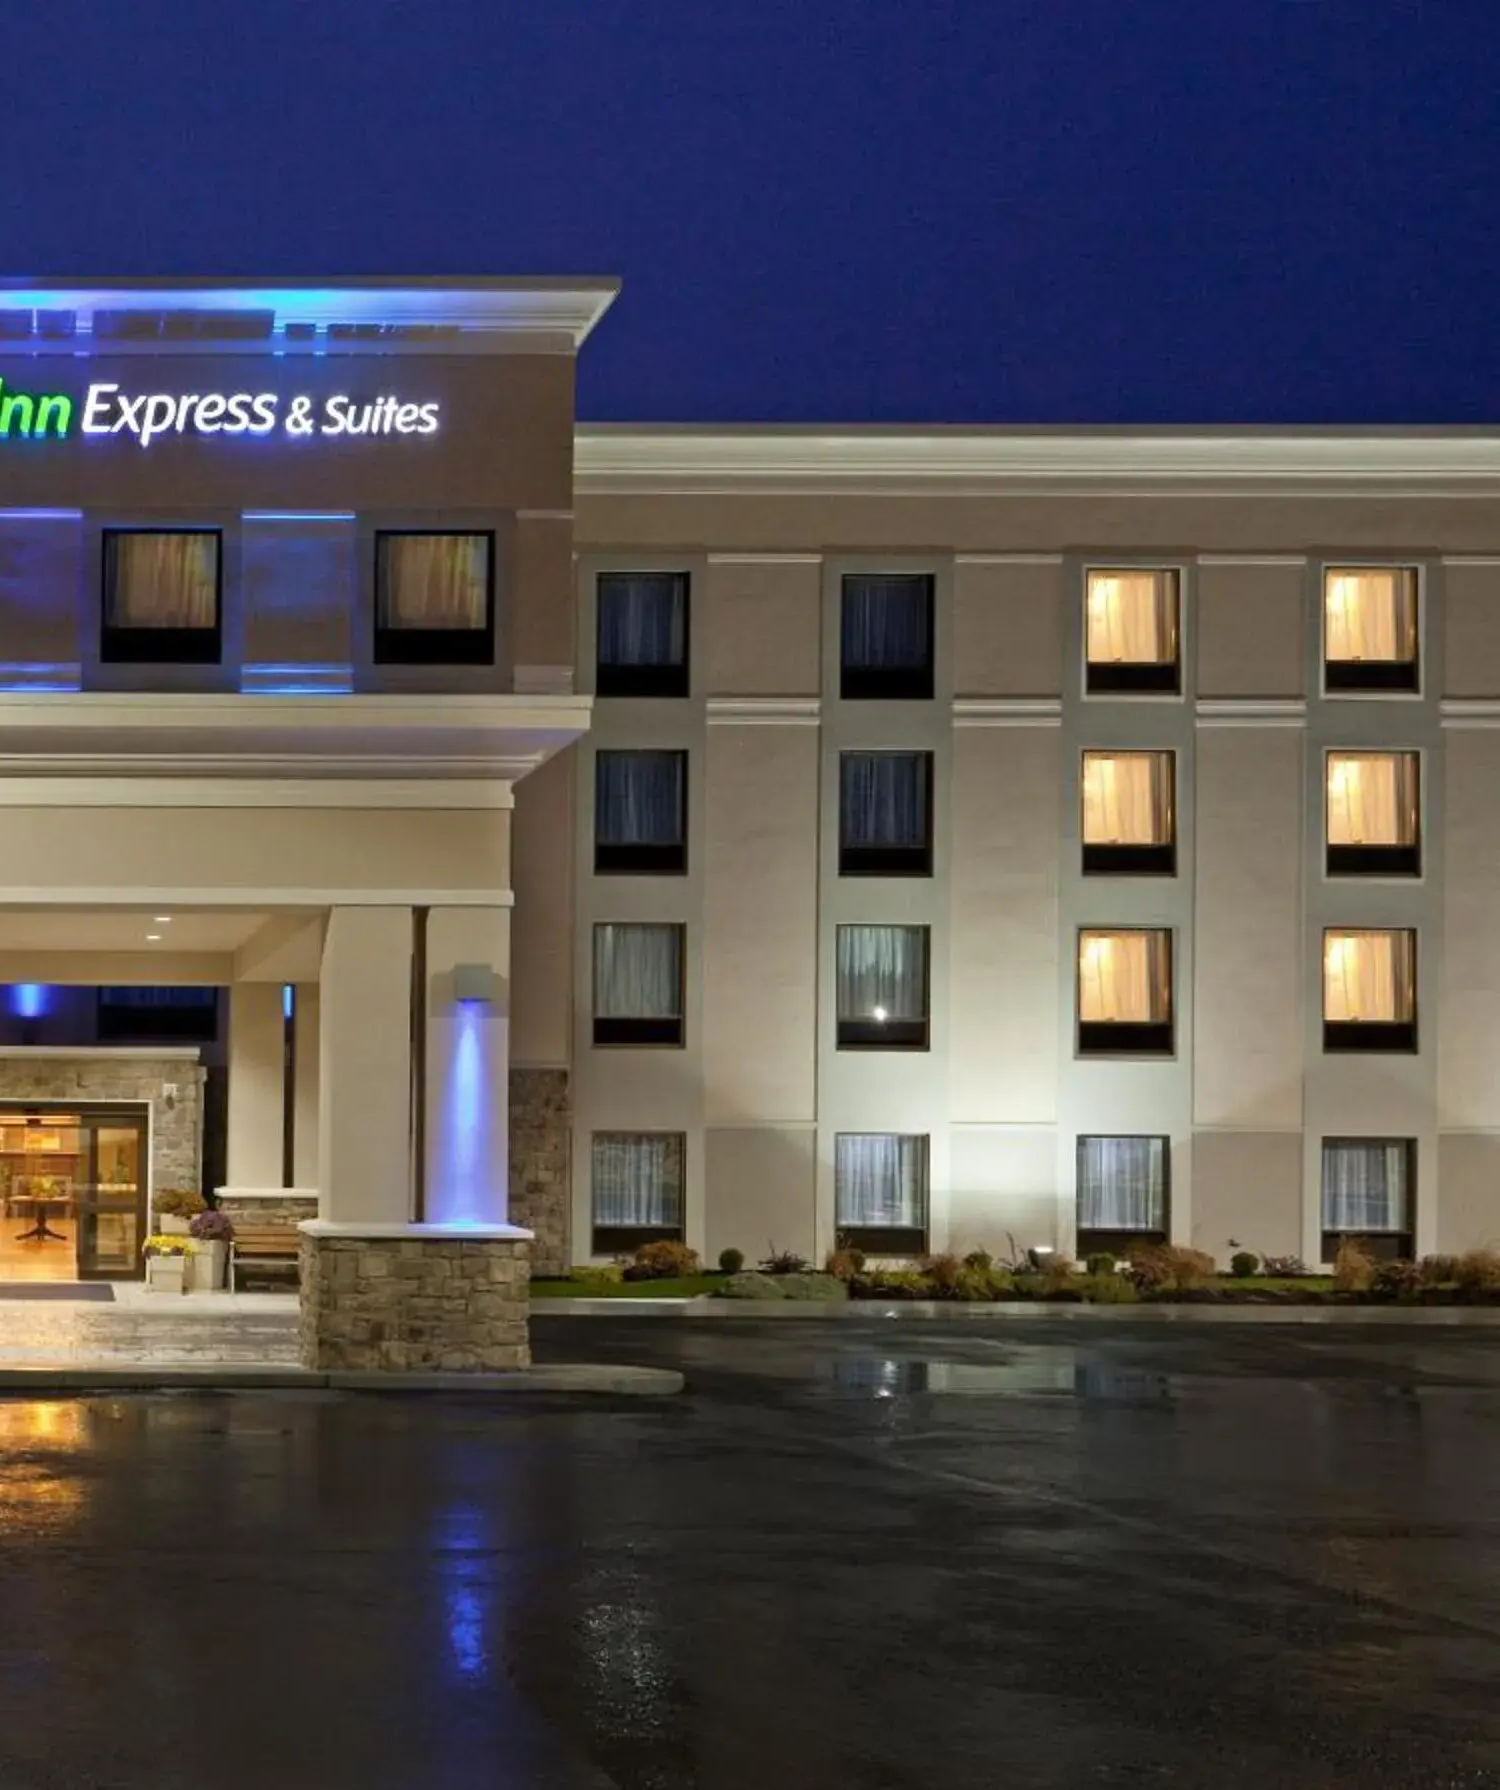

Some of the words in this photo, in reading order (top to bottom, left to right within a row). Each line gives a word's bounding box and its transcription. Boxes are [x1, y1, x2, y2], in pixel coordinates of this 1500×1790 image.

[81, 383, 278, 448] Express
[285, 396, 314, 434] &
[321, 395, 440, 434] Suites
